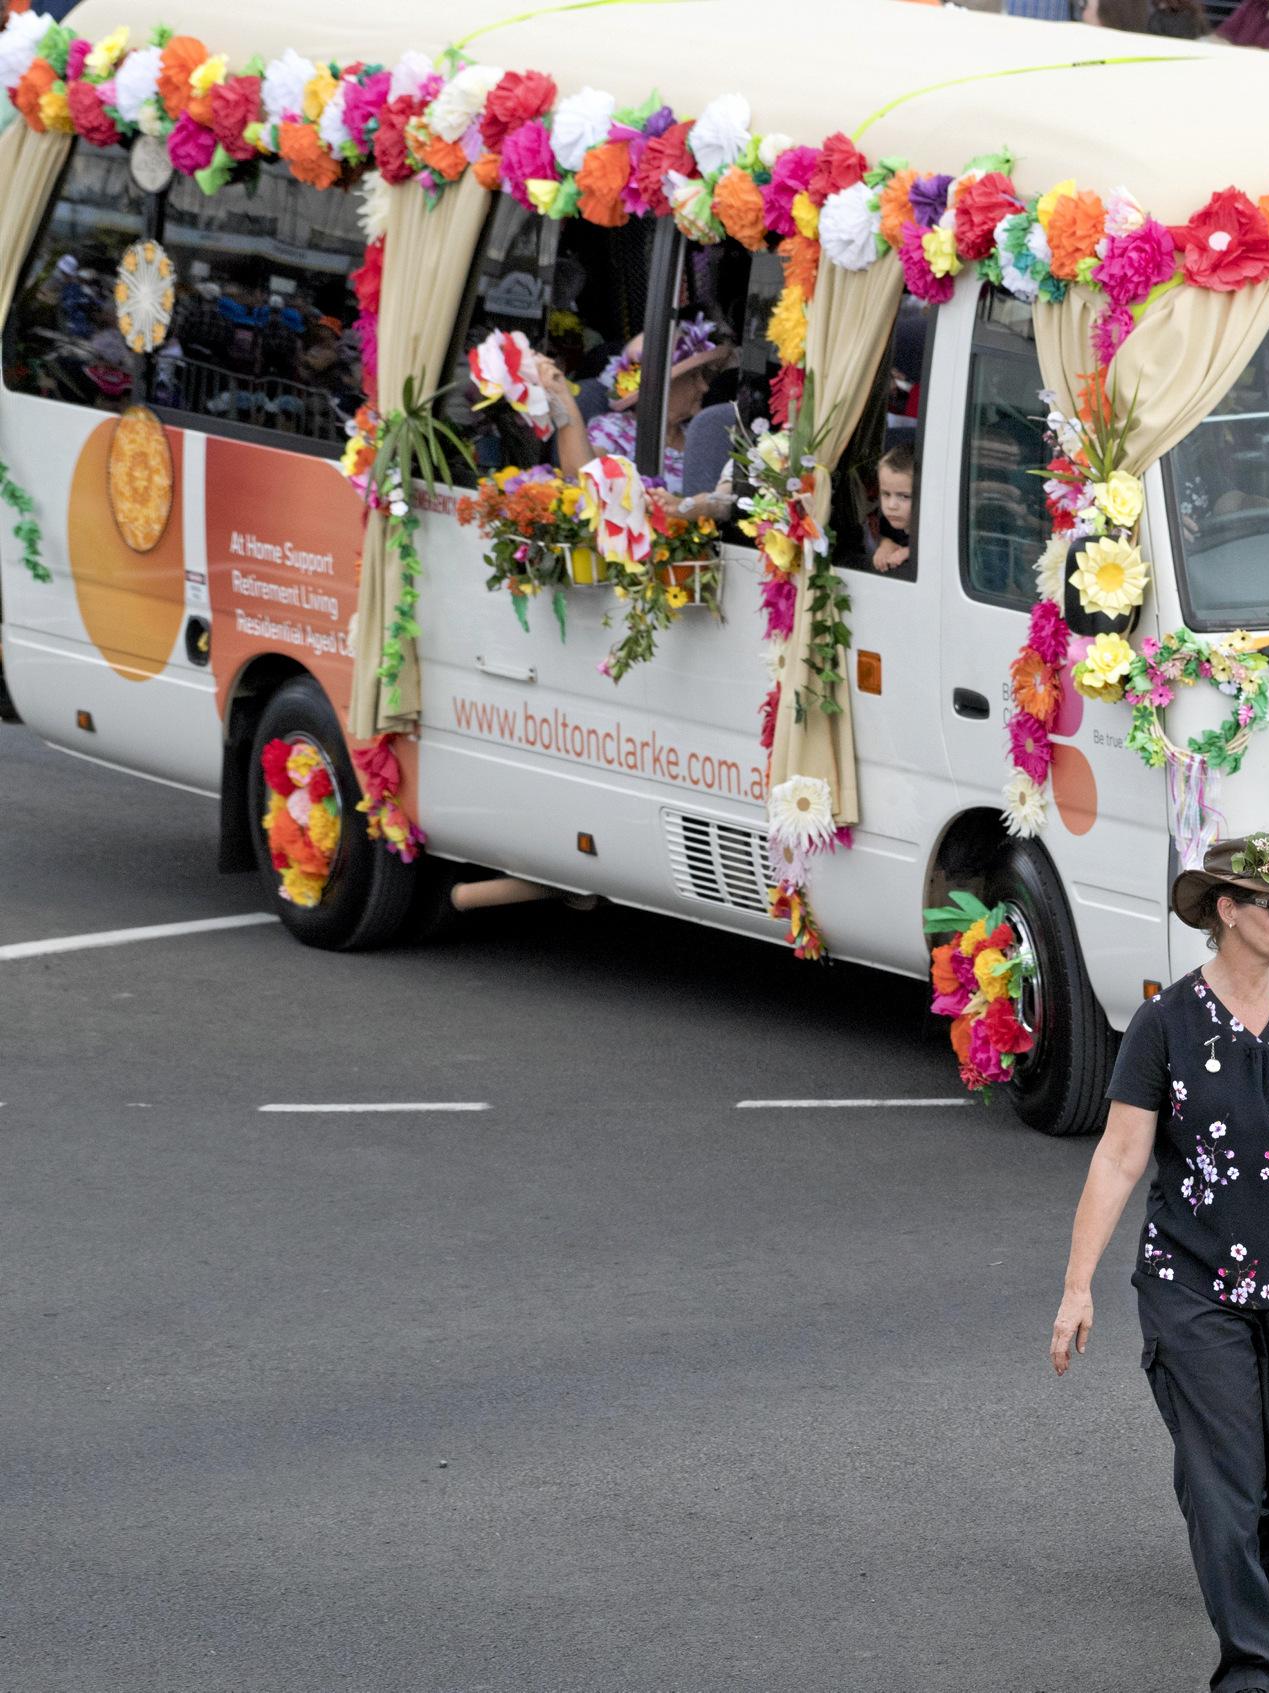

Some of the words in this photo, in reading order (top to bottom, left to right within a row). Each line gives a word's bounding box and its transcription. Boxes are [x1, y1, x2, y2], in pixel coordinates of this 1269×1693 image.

[229, 531, 245, 556] At
[245, 533, 283, 564] Home
[283, 541, 334, 575] Support
[231, 569, 301, 607] Retirement
[300, 584, 338, 620] Living
[235, 608, 305, 646] Residential
[305, 625, 337, 655] Aged
[452, 696, 769, 801] www.boltonclarke.com.a
[1093, 729, 1105, 744] Be
[1106, 734, 1123, 748] true
